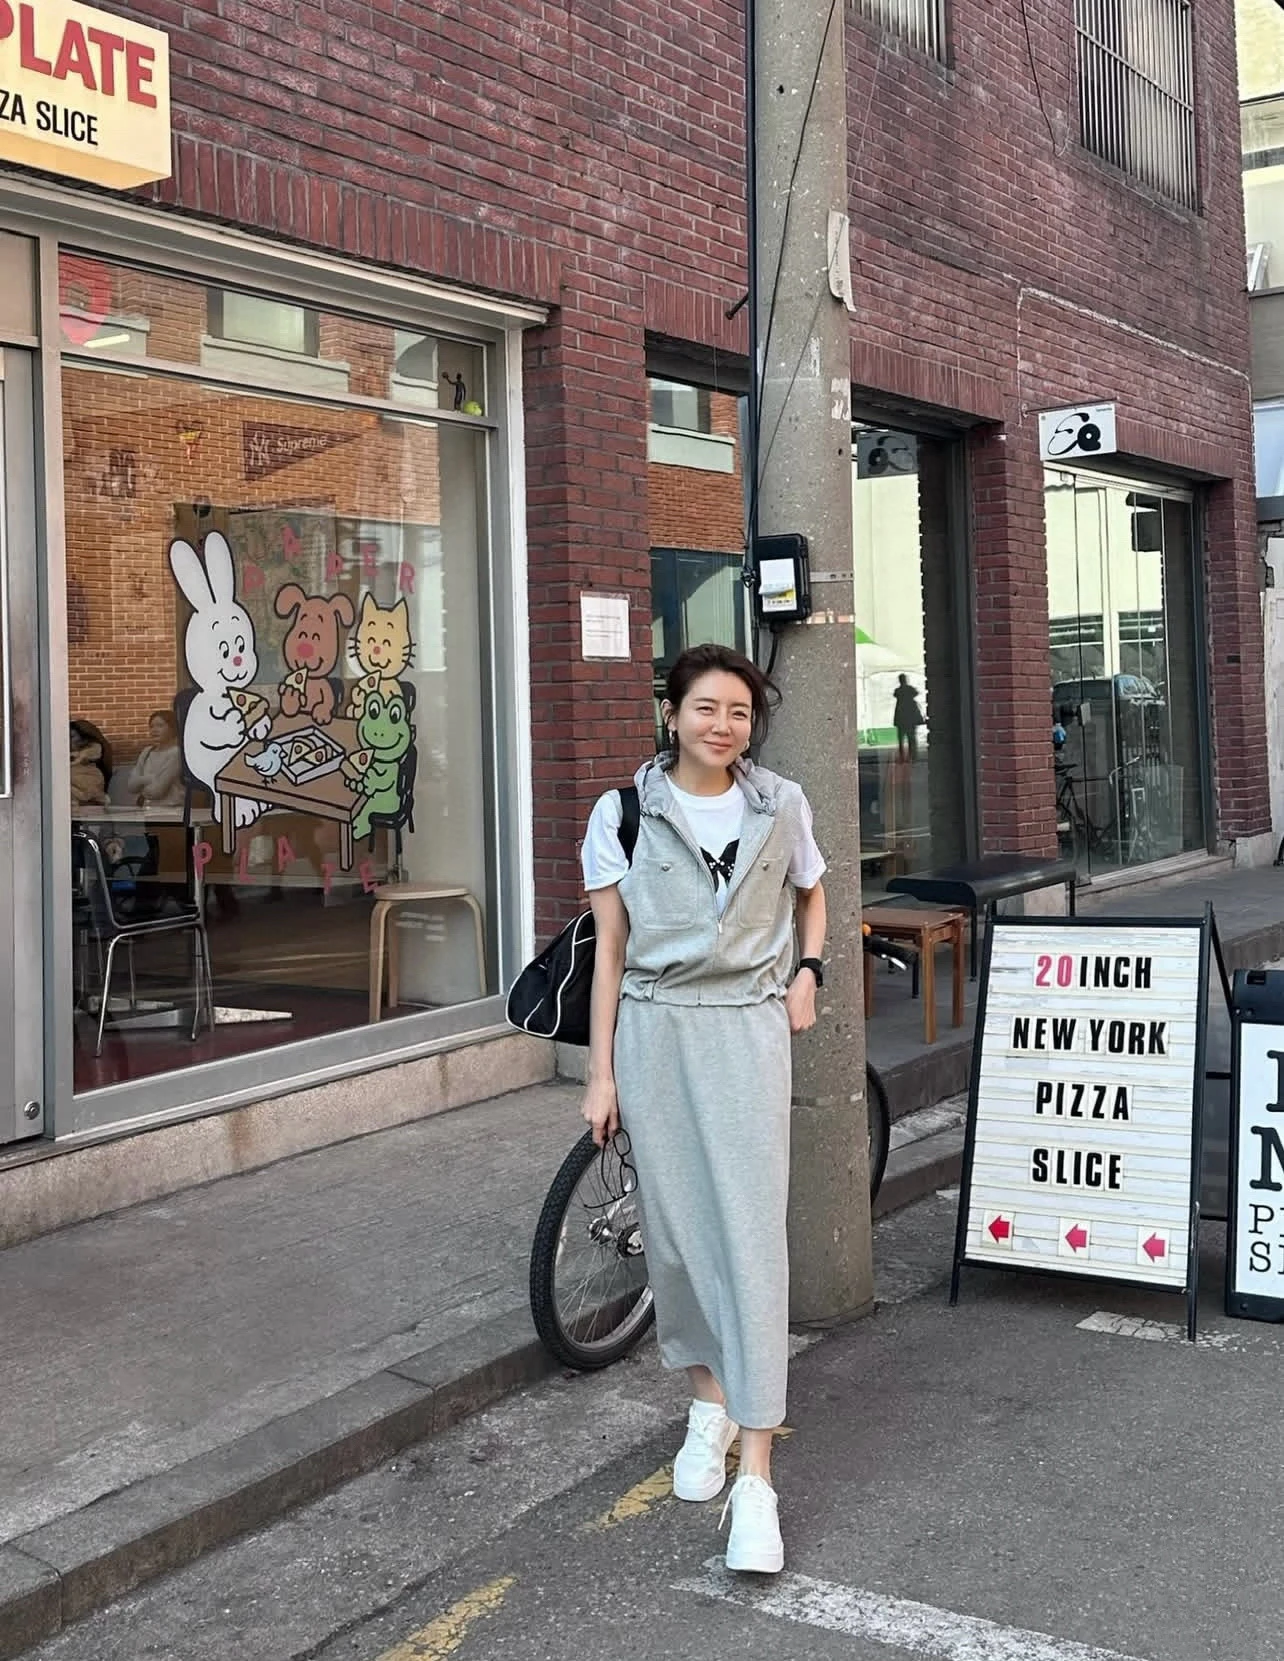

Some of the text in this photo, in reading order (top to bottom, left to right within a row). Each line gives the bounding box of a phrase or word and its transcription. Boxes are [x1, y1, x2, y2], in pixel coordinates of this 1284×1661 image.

[36, 100, 99, 146] SLICE
[192, 836, 379, 895] PLATE
[1012, 1017, 1167, 1055] NEW YORK
[1035, 1081, 1130, 1121] PIZZA
[1031, 1148, 1122, 1190] SLICE
[1248, 1203, 1284, 1235] P
[1248, 1240, 1284, 1275] S
